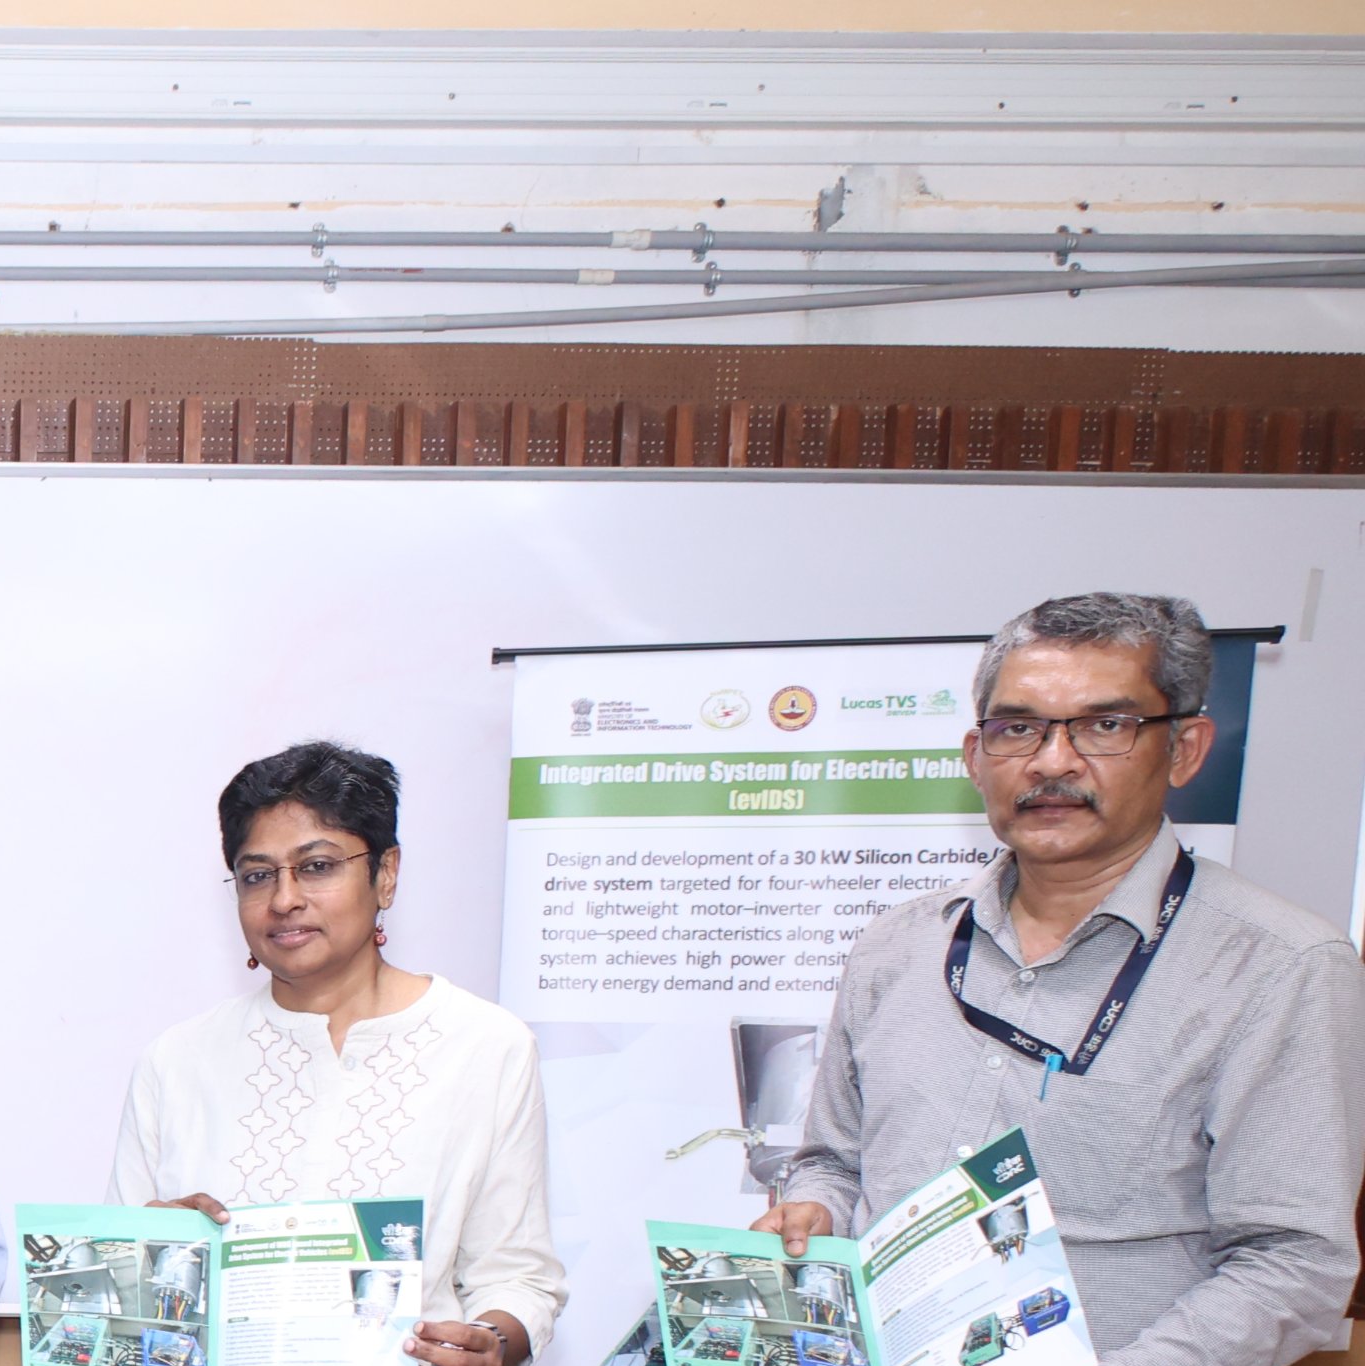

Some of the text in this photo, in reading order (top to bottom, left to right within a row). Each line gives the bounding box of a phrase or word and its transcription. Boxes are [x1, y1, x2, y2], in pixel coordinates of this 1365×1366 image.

[840, 695, 916, 709] Lucas TVS
[539, 757, 908, 785] Integrated Drive System for Electric
[728, 789, 804, 811] (evIDS)
[546, 848, 988, 869] Design and development of a 30 kW Silicon Carbide
[544, 876, 586, 891] drive
[593, 877, 652, 893] system
[660, 875, 730, 894] targeted
[738, 875, 761, 890] for
[768, 874, 881, 890] four-wheeler
[542, 901, 678, 919] and lightweight
[661, 925, 834, 943] characteristics along
[539, 950, 785, 969] system achieves high power
[538, 974, 769, 993] battery energy demand and
